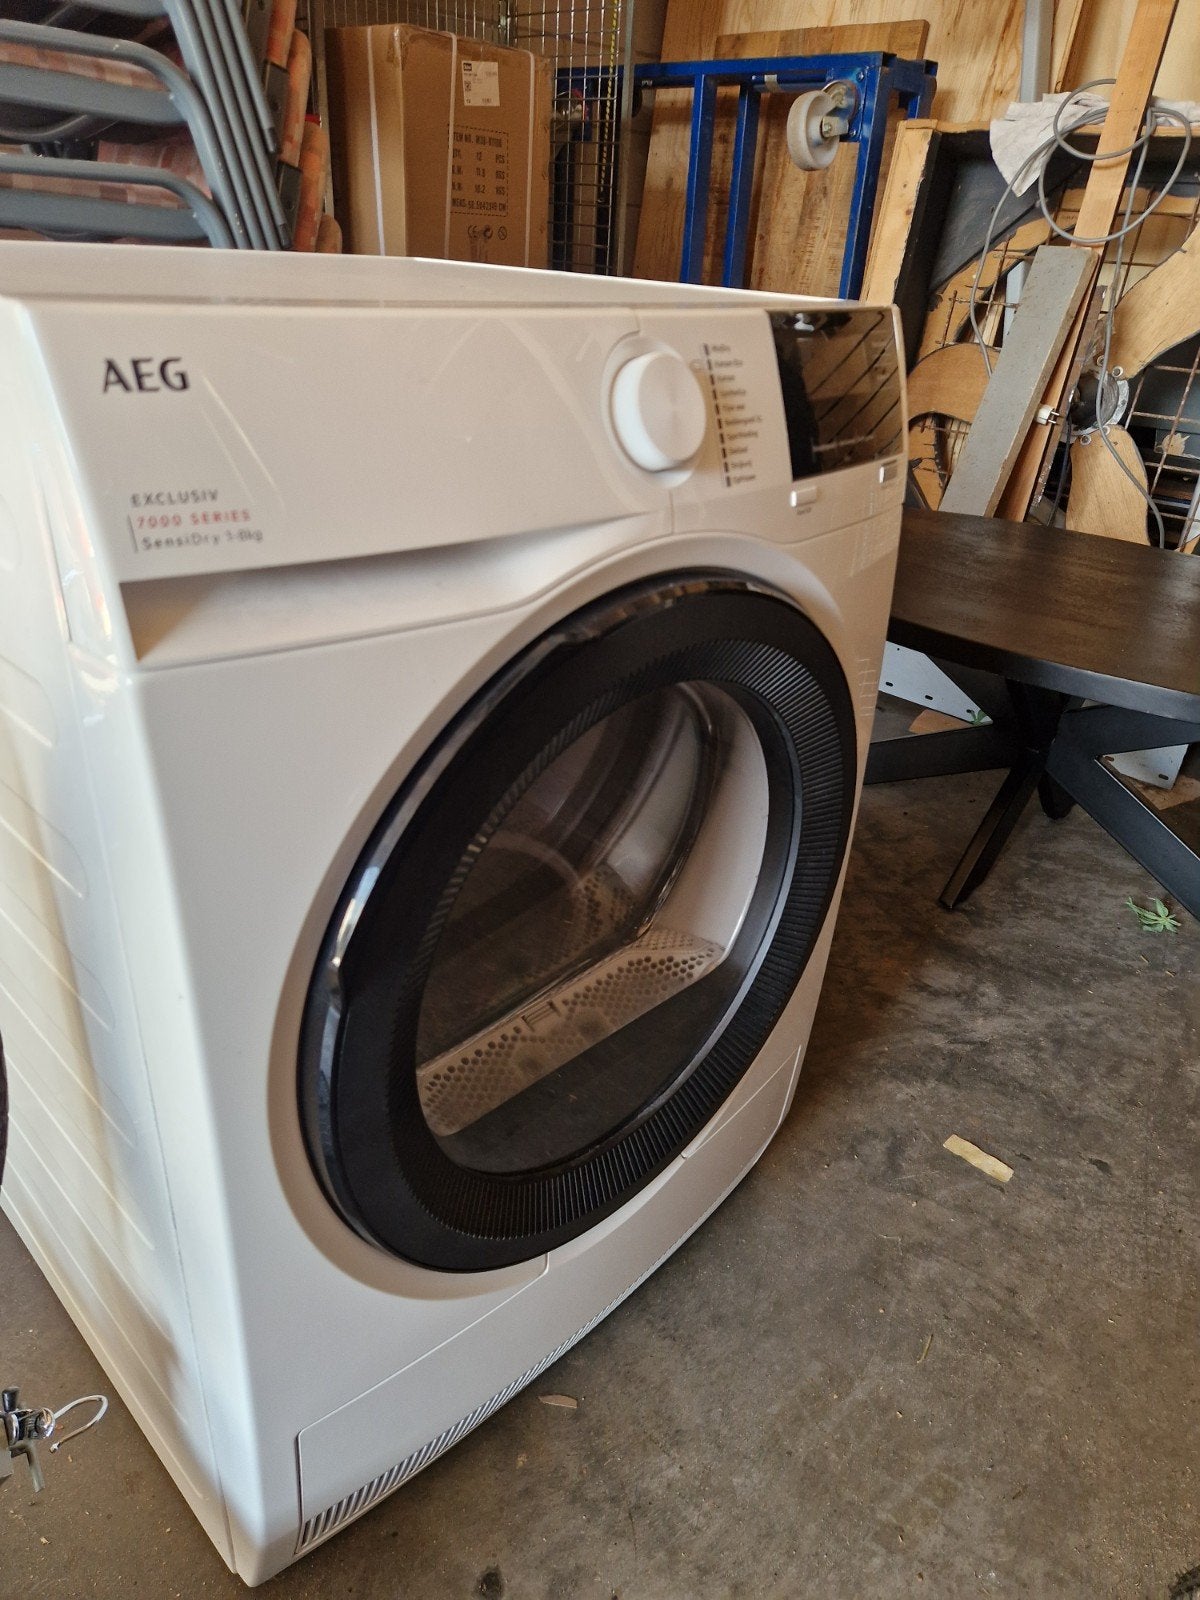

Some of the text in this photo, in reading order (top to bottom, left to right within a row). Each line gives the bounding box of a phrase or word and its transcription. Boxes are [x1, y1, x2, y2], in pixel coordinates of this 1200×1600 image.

[102, 356, 190, 394] AEG
[130, 490, 218, 507] EXCLUSIV
[136, 508, 251, 529] 7000 SERIES
[142, 533, 221, 550] SensiDry
